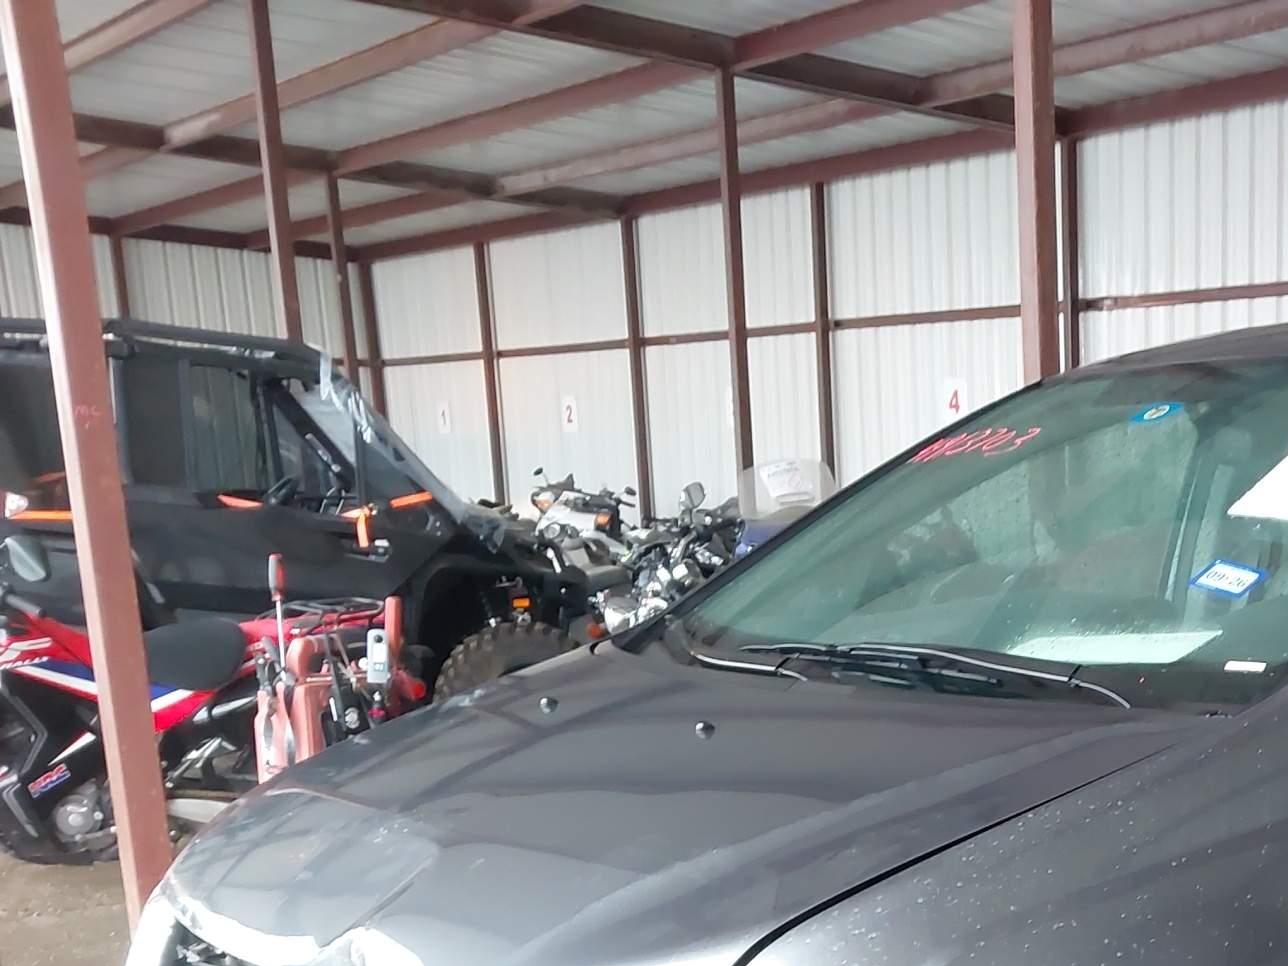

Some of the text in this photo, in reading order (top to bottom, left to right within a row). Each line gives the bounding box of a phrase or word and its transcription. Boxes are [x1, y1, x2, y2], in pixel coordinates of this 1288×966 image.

[949, 389, 960, 414] 4
[441, 409, 447, 426] 1
[565, 404, 573, 423] 2
